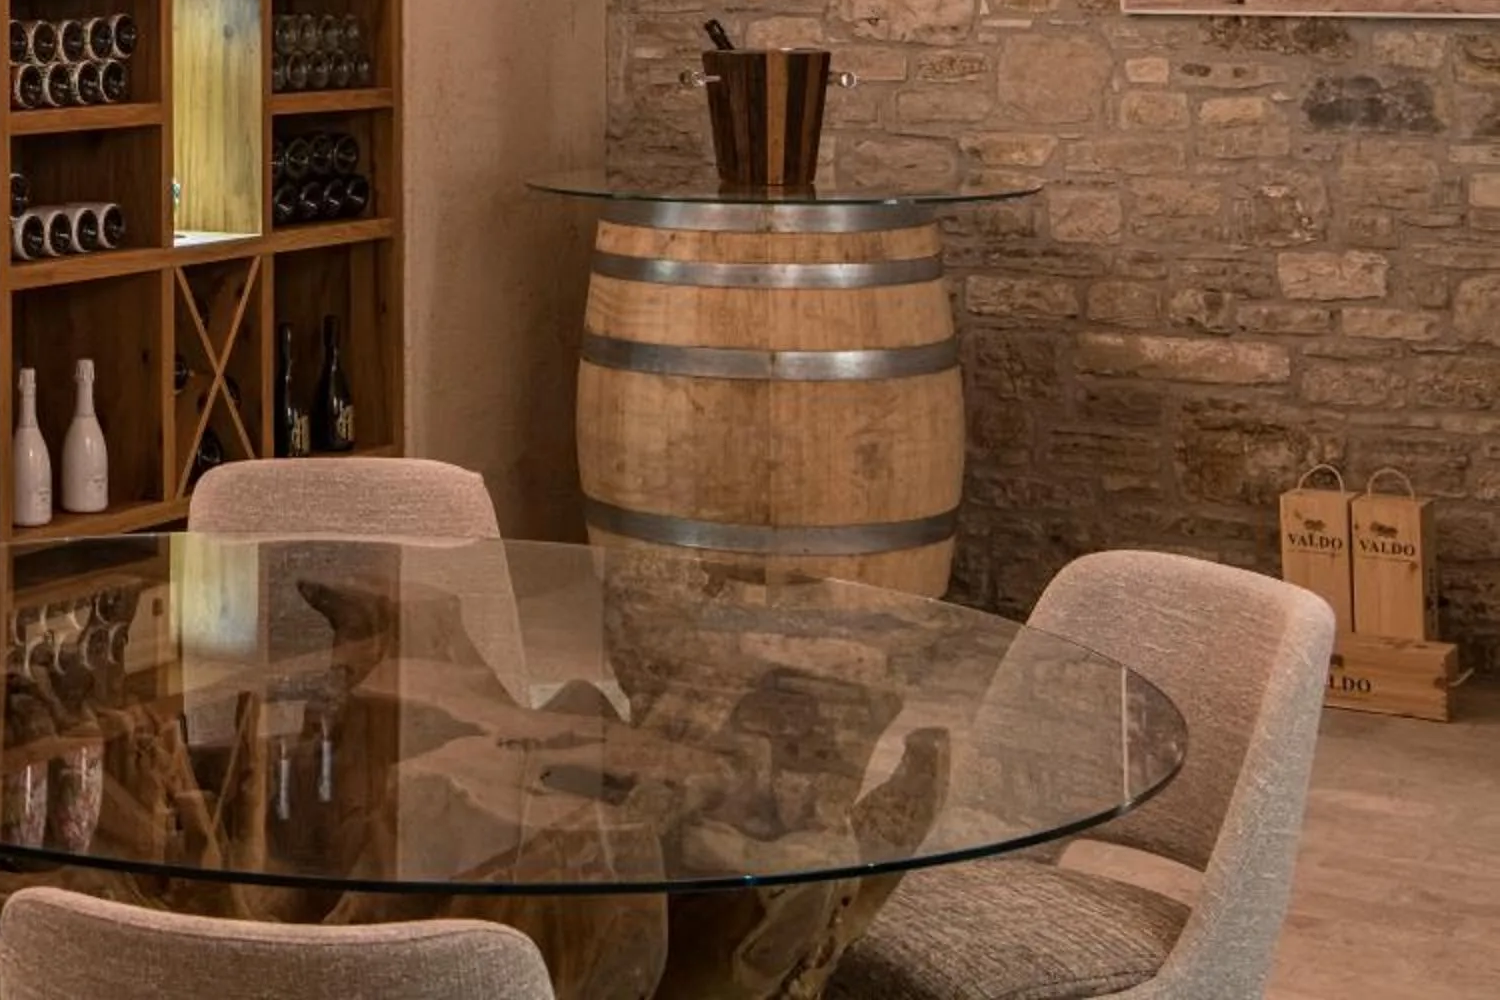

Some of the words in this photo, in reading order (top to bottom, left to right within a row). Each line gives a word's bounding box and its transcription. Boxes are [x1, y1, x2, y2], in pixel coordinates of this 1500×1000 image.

[1287, 532, 1343, 550] VALDO
[1359, 539, 1415, 557] VALDO
[1329, 674, 1371, 693] LDO
